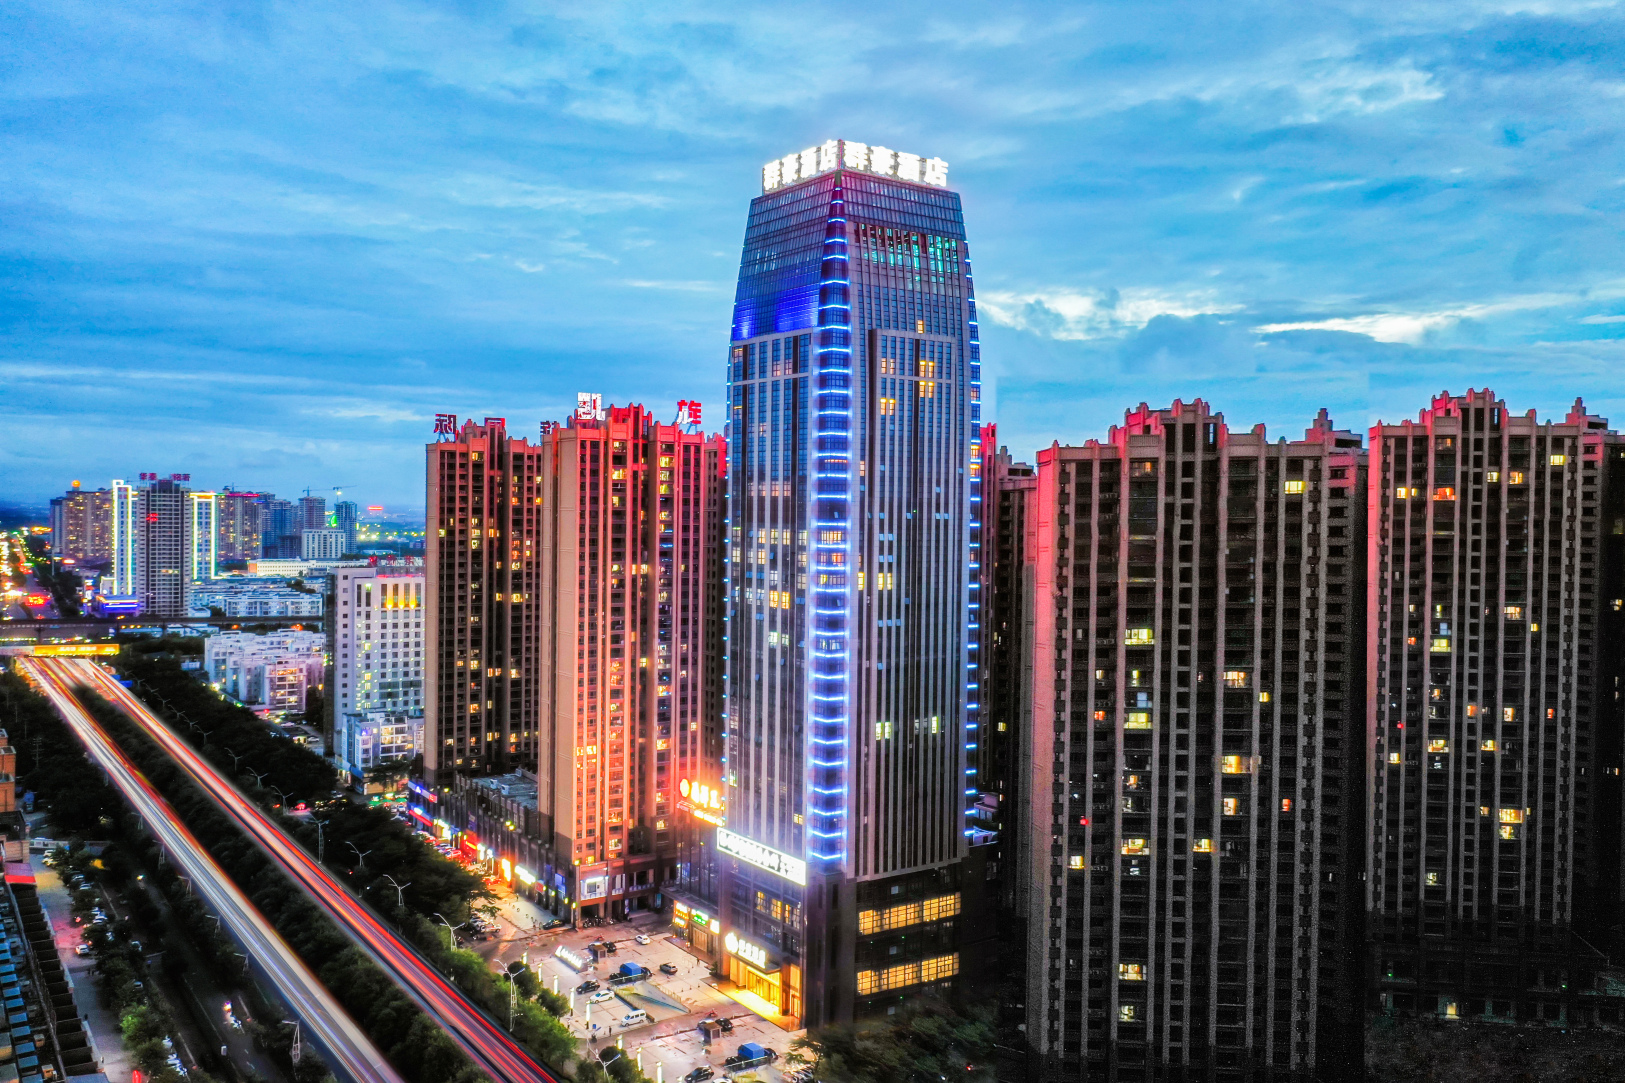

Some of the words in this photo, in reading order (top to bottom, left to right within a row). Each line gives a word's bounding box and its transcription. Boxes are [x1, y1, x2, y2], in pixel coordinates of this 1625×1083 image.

[764, 139, 838, 191] 群豪酒店
[844, 140, 949, 187] 群豪酒店
